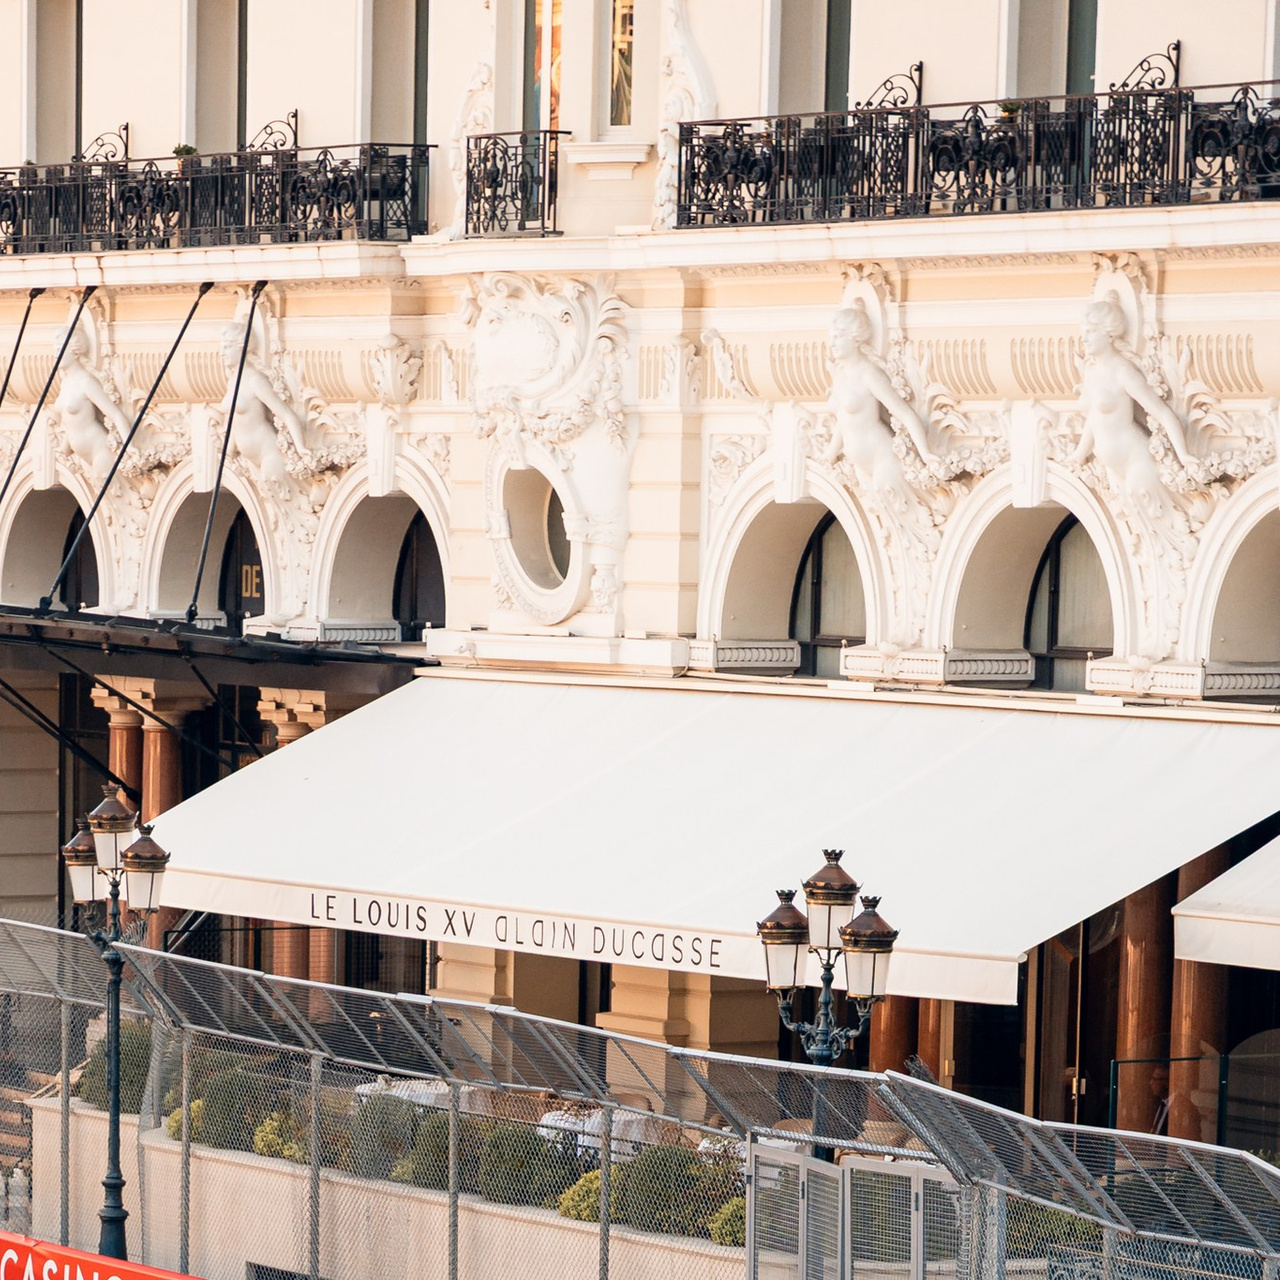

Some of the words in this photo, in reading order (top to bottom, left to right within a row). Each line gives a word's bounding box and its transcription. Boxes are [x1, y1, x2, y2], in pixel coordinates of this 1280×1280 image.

[310, 893, 337, 921] LE
[353, 898, 428, 932] LOUIS
[443, 908, 477, 938] XV
[593, 927, 722, 968] DUCASSE
